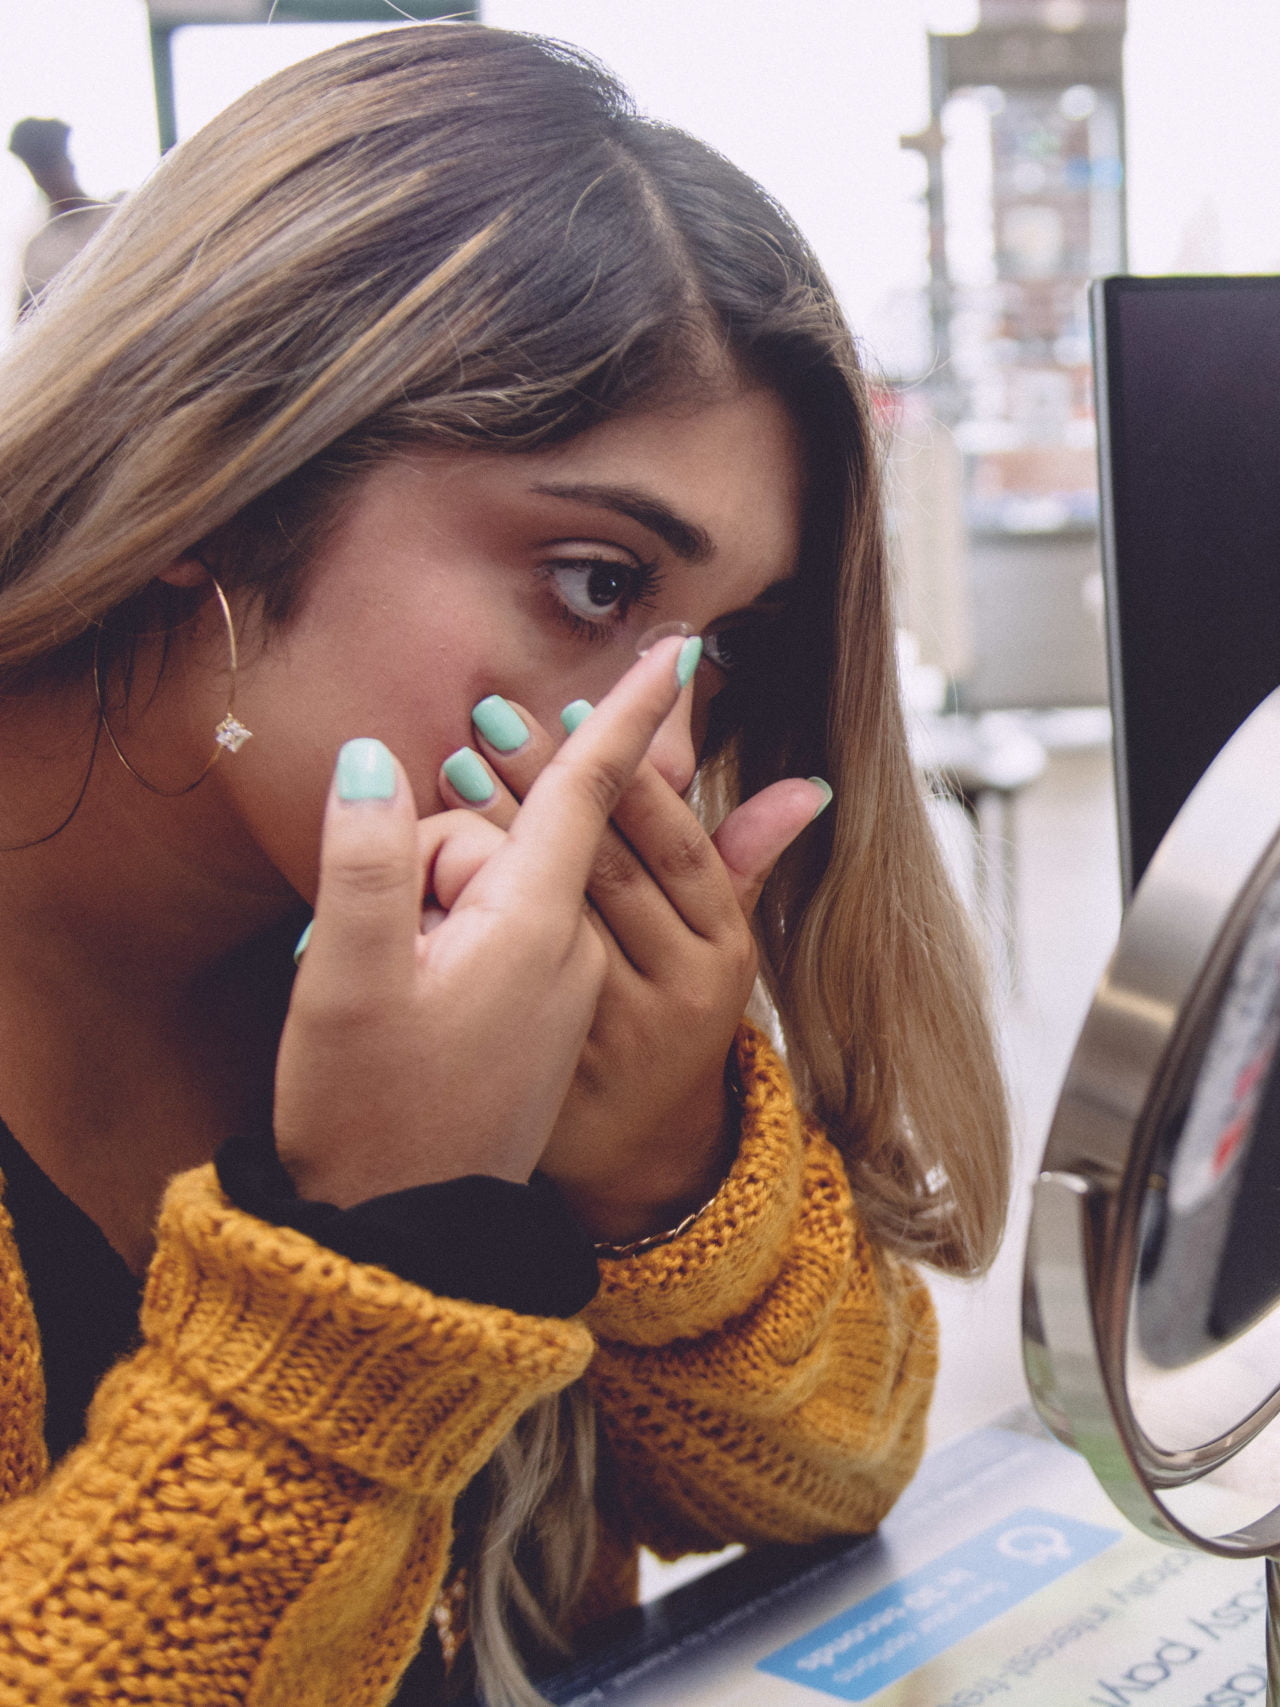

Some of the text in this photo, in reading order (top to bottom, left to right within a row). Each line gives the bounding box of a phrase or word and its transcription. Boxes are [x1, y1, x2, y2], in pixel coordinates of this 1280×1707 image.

[1106, 1550, 1195, 1605] otally
[1186, 1578, 1268, 1641] asy
[1089, 1636, 1202, 1707] pay
